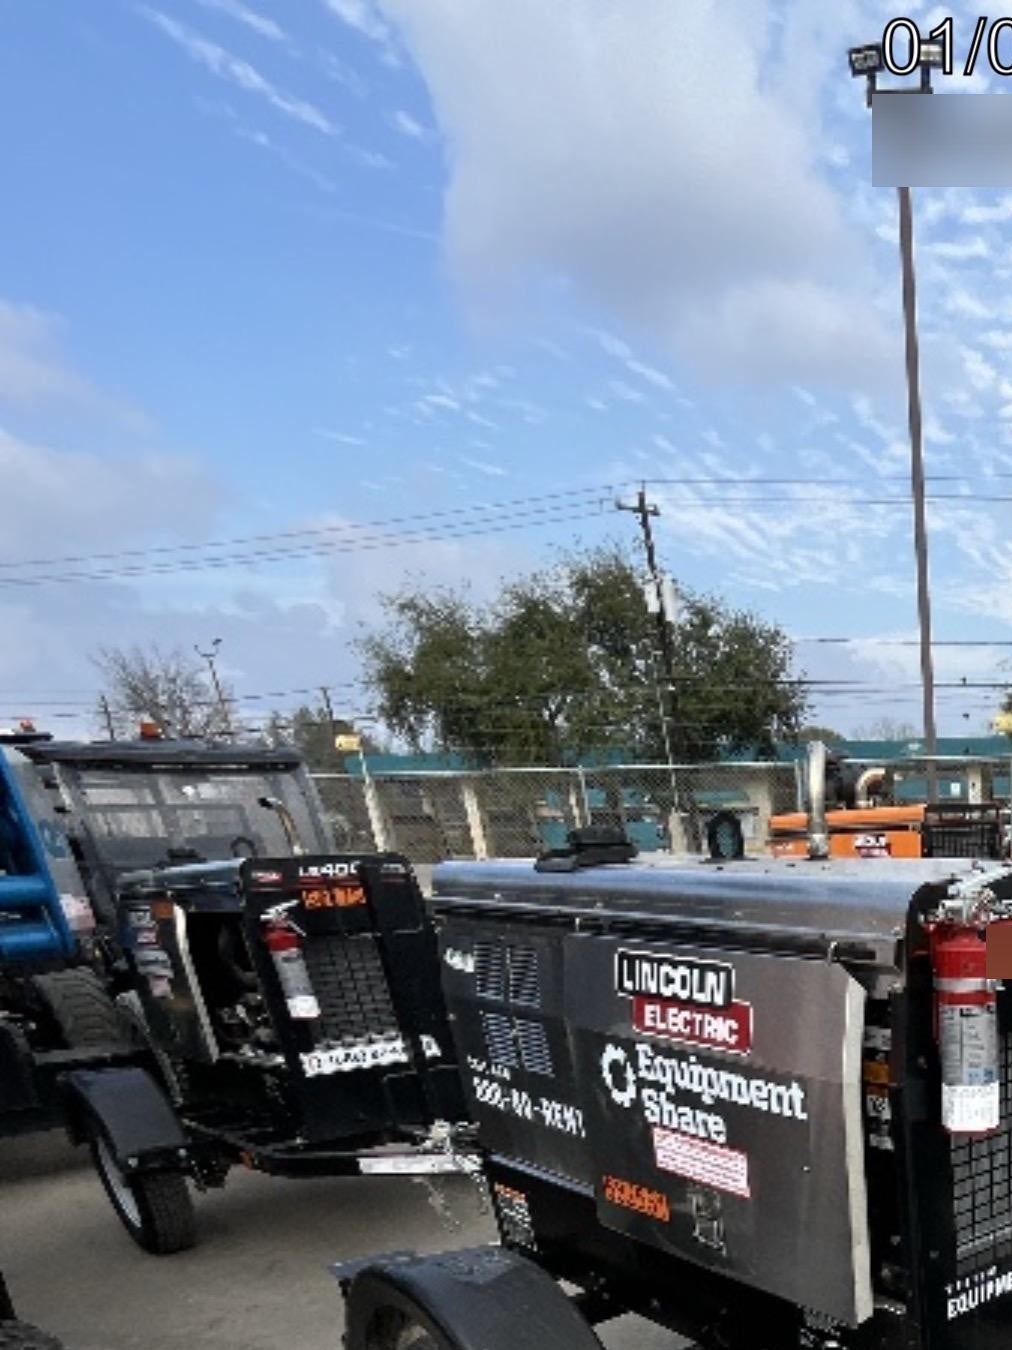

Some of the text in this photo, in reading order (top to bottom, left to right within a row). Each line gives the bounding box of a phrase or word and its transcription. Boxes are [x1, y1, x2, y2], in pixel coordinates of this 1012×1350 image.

[622, 958, 727, 1006] LINCOLN
[643, 1003, 739, 1045] ELECTRIC
[635, 1043, 808, 1120] Equipment
[641, 1088, 728, 1144] Share
